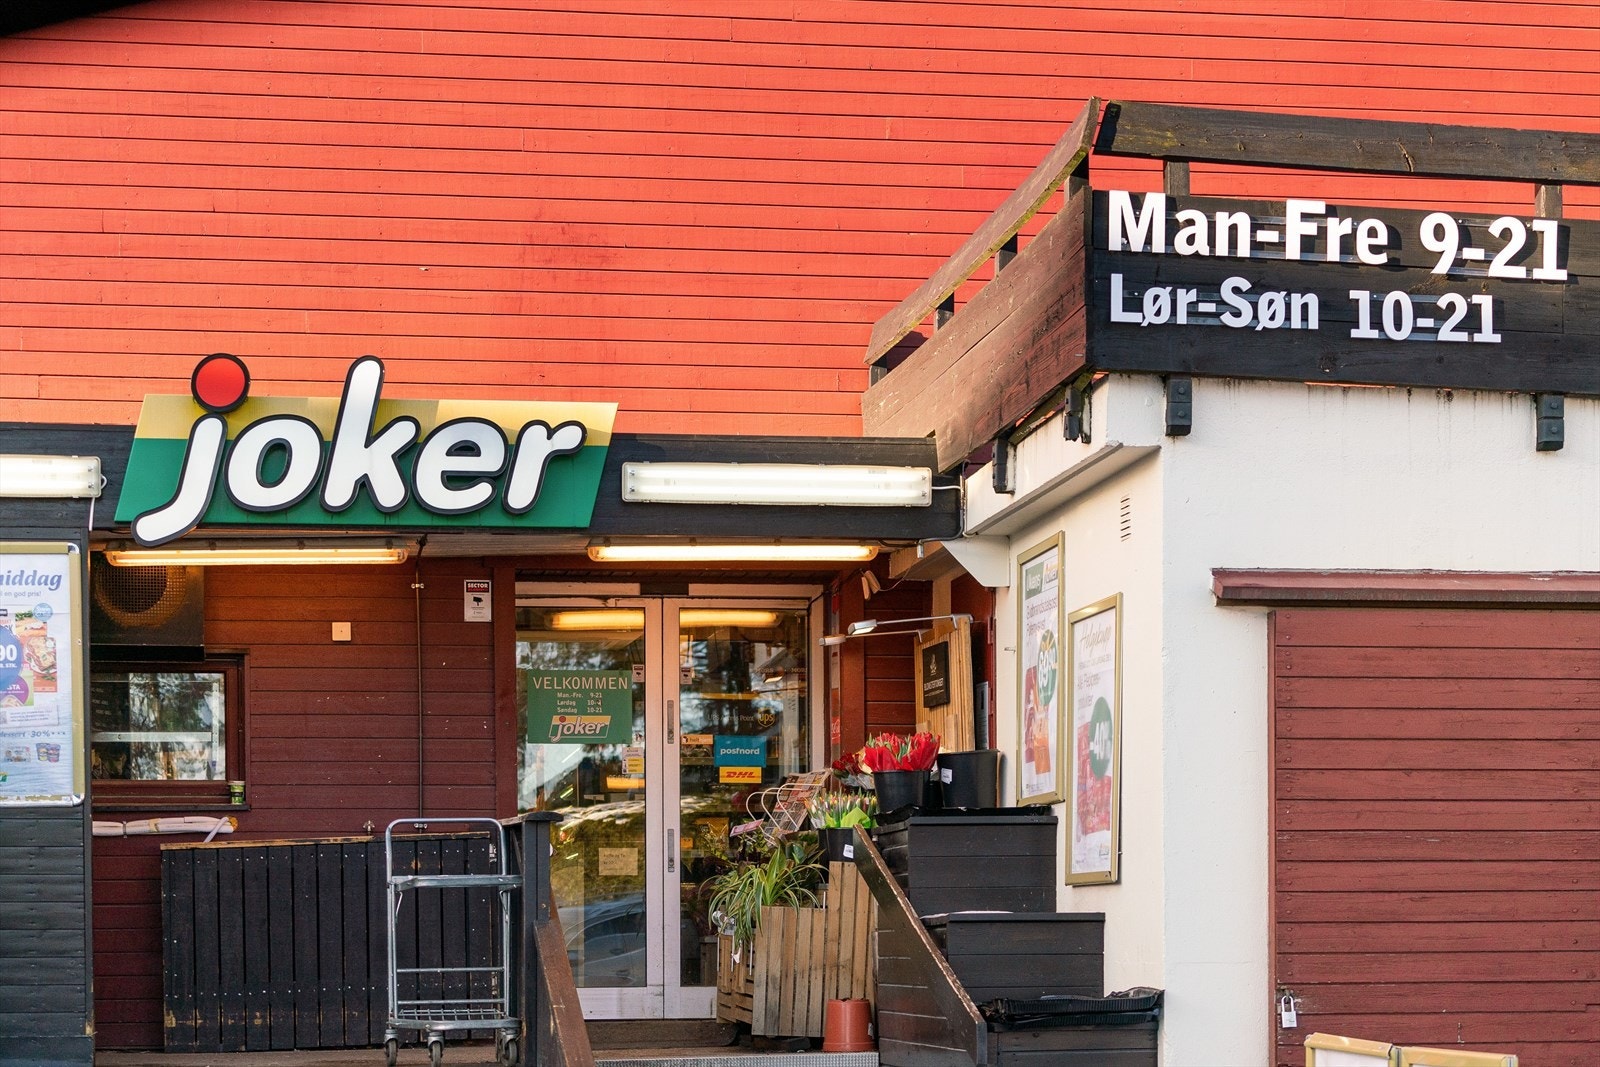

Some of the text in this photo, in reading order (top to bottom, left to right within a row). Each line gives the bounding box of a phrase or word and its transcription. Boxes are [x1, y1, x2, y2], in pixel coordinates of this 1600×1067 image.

[1108, 190, 1568, 281] Man-Fre 9-21
[1110, 273, 1502, 343] Lør-Søn 10-21
[131, 352, 588, 547] joker
[533, 677, 628, 689] VELKOMMEN
[551, 715, 606, 742] joker
